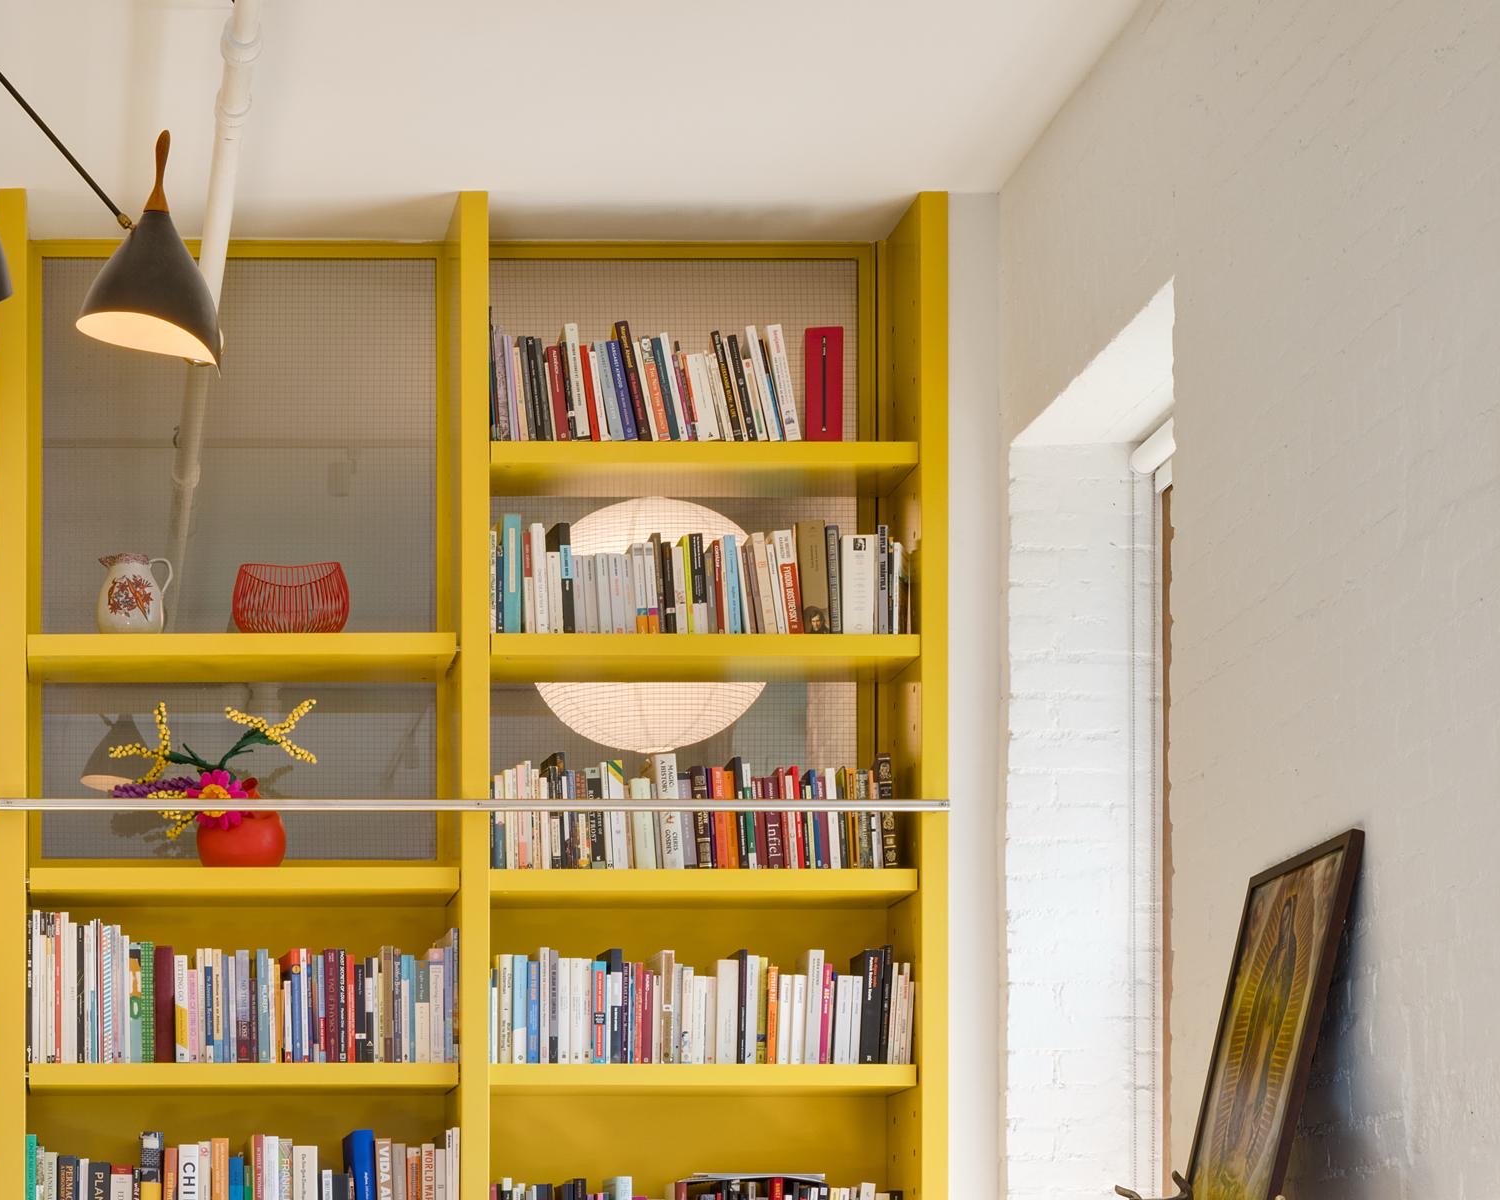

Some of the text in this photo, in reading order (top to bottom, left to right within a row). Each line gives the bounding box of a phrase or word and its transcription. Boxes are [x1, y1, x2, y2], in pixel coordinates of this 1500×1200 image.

[783, 567, 797, 622] FYODOR DOSTOEVSKY
[768, 823, 780, 857] Infiel
[177, 990, 184, 1001] GO
[281, 1159, 290, 1191] FRANK
[379, 1147, 390, 1182] VIDA
[425, 1150, 433, 1180] WORLD
